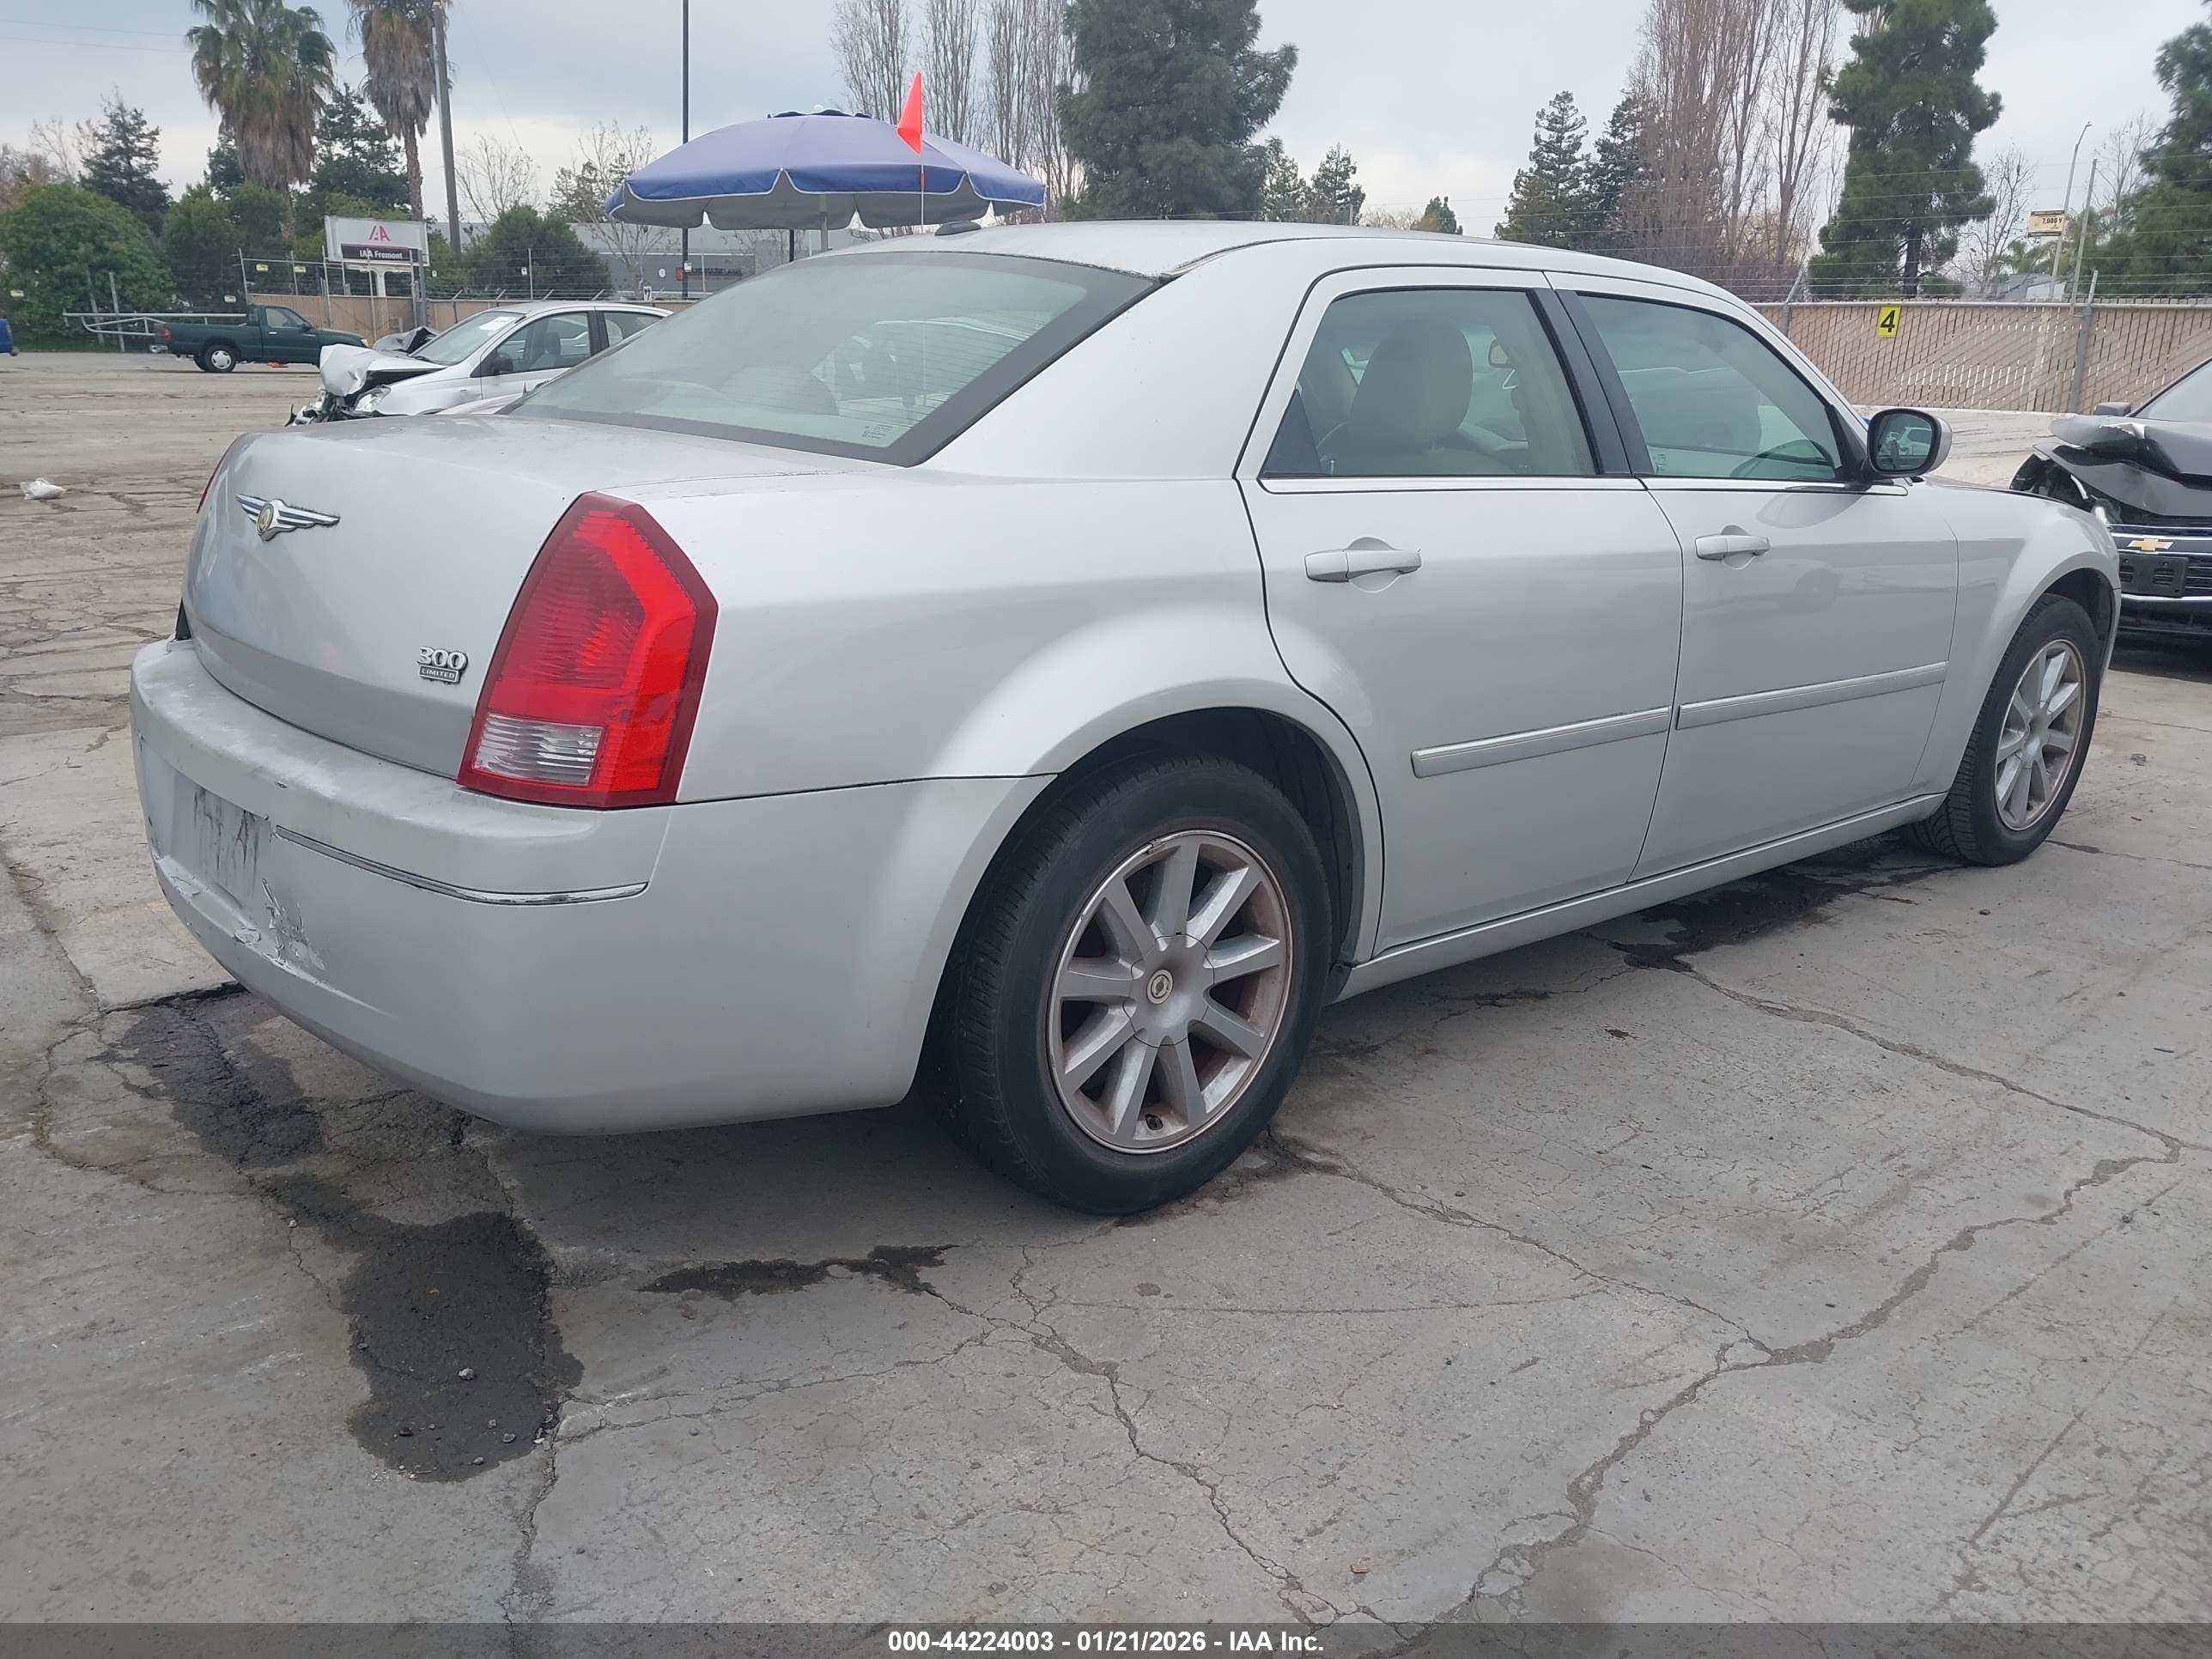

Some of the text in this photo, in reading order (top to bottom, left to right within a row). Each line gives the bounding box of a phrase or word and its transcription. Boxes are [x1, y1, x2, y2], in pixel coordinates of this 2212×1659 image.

[359, 249, 403, 259] IAA Fremont
[1880, 310, 1896, 332] 4
[416, 647, 468, 671] 300
[422, 668, 455, 678] LIMITED
